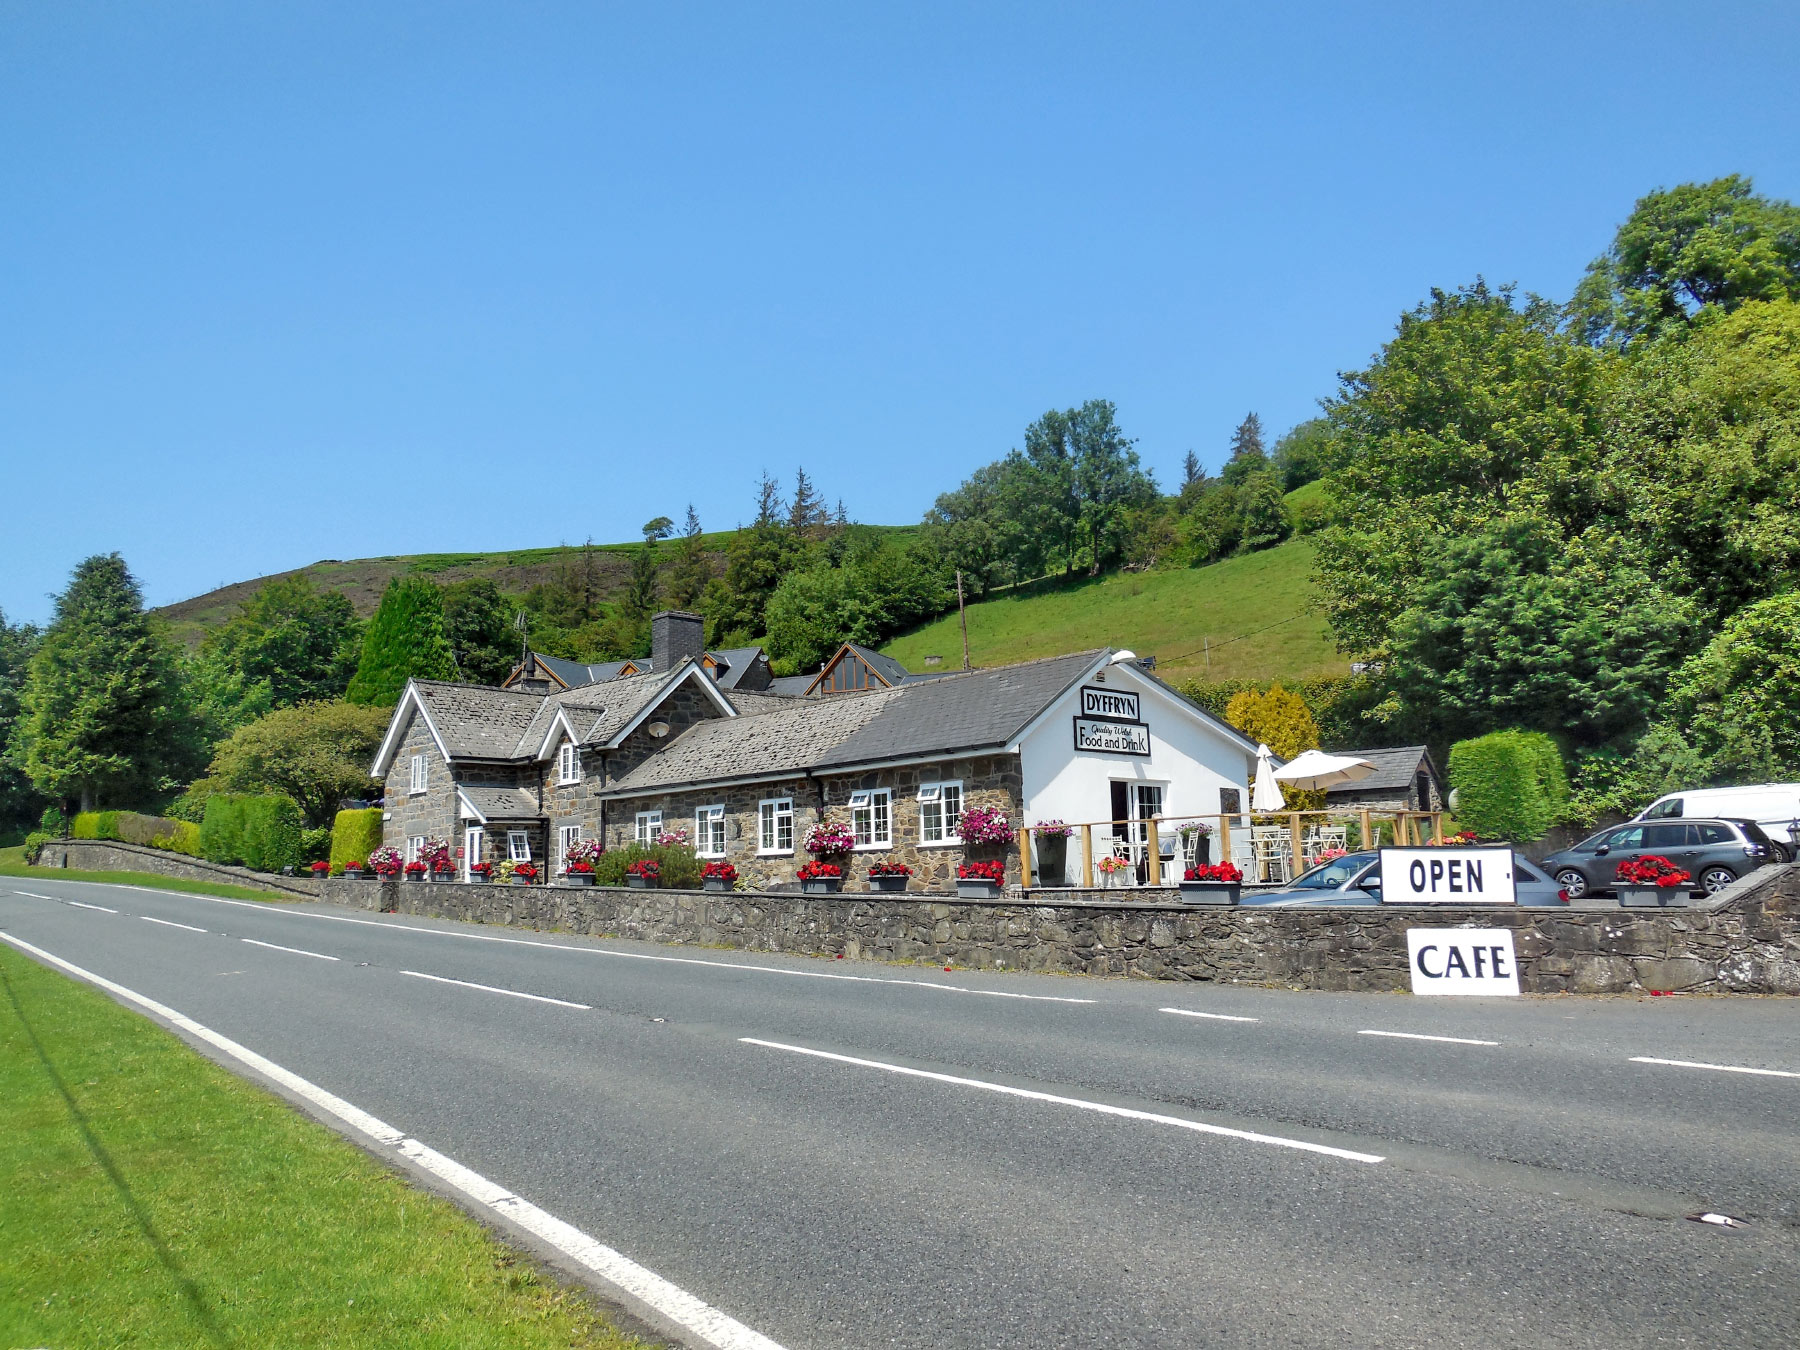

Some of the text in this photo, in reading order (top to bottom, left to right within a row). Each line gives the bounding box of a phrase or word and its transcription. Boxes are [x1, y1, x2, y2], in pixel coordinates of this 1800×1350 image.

[1087, 693, 1135, 716] DYFFRYN
[1080, 726, 1146, 751] Food and Drink
[1092, 725, 1113, 736] Quality
[1410, 859, 1484, 892] OPEN
[1417, 945, 1511, 978] CAFE
